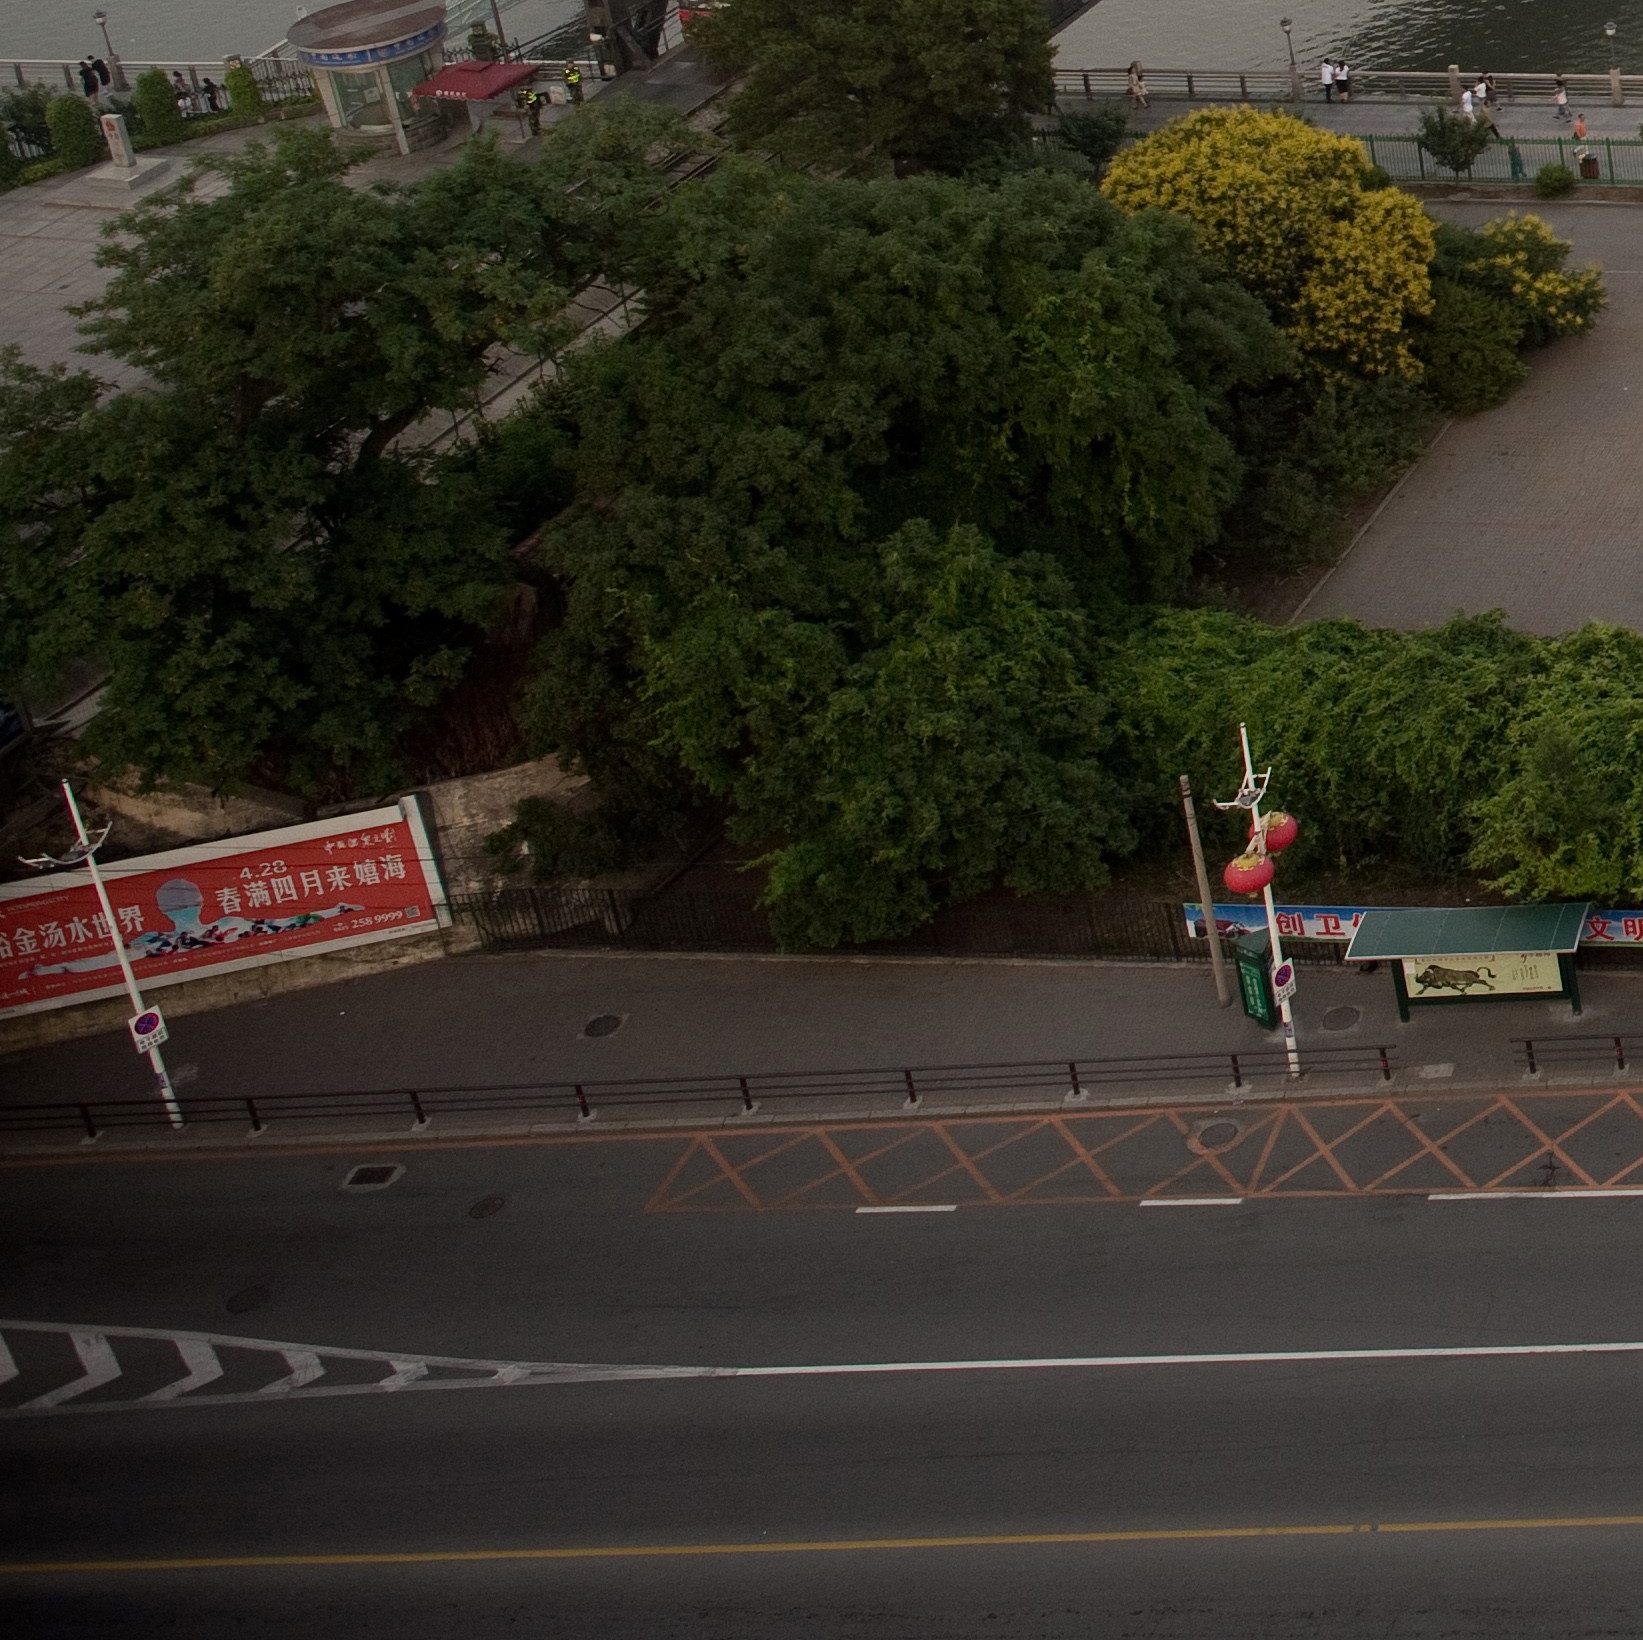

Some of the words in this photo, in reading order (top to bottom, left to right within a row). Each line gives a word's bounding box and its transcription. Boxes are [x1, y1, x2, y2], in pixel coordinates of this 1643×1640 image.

[240, 859, 288, 880] 4.28
[215, 854, 407, 915] 春满四月来嬉海
[351, 916, 373, 928] 258
[374, 909, 403, 924] 9999
[1276, 912, 1360, 935] 创卫
